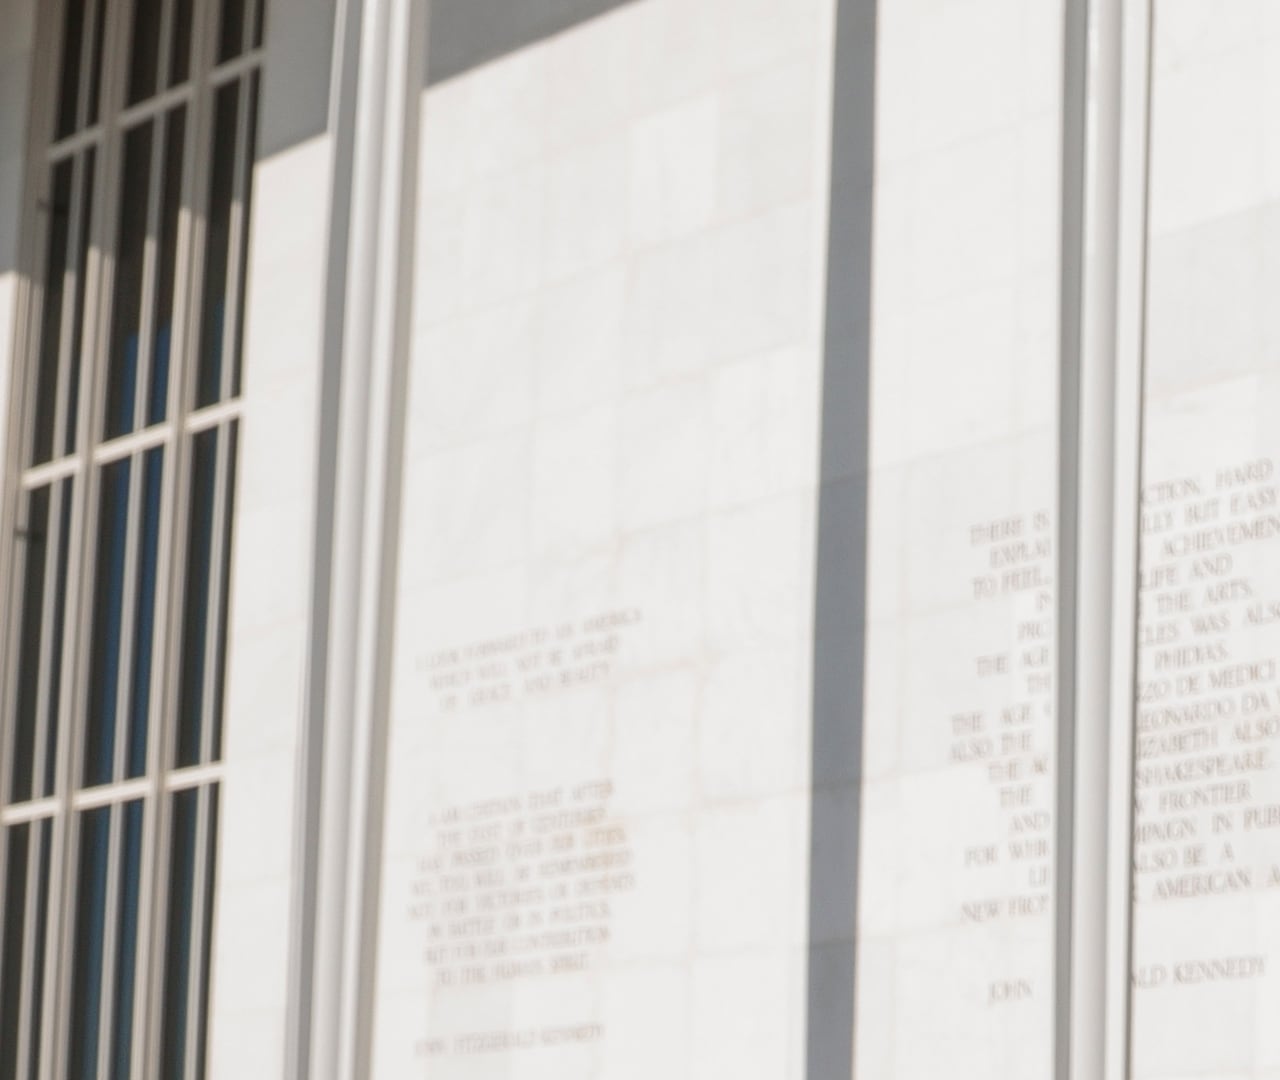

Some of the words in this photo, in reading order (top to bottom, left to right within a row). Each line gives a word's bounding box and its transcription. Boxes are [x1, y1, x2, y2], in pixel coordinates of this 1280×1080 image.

[1217, 458, 1273, 487] HARD
[1185, 499, 1220, 522] BUT
[1231, 485, 1279, 512] EASY
[1190, 553, 1233, 578] AND
[972, 577, 996, 598] TO
[1157, 589, 1192, 613] THE
[977, 653, 1007, 676] THE
[1192, 612, 1229, 634] WAS
[952, 711, 985, 733] THE
[1002, 703, 1033, 726] AGE
[1177, 672, 1202, 695] DE
[1209, 660, 1275, 688] MEDICI
[950, 737, 992, 762] ALSO
[1002, 730, 1032, 754] THE
[1242, 691, 1269, 714] DA
[1160, 781, 1251, 811] FRONTIER
[1213, 812, 1232, 833] IN
[1185, 844, 1205, 865] BE
[1221, 841, 1234, 860] A
[961, 898, 1000, 923] NEW
[1155, 869, 1251, 899] AMERICAN
[989, 980, 1031, 1005] JOHN
[1174, 955, 1265, 982] KENNEDY
